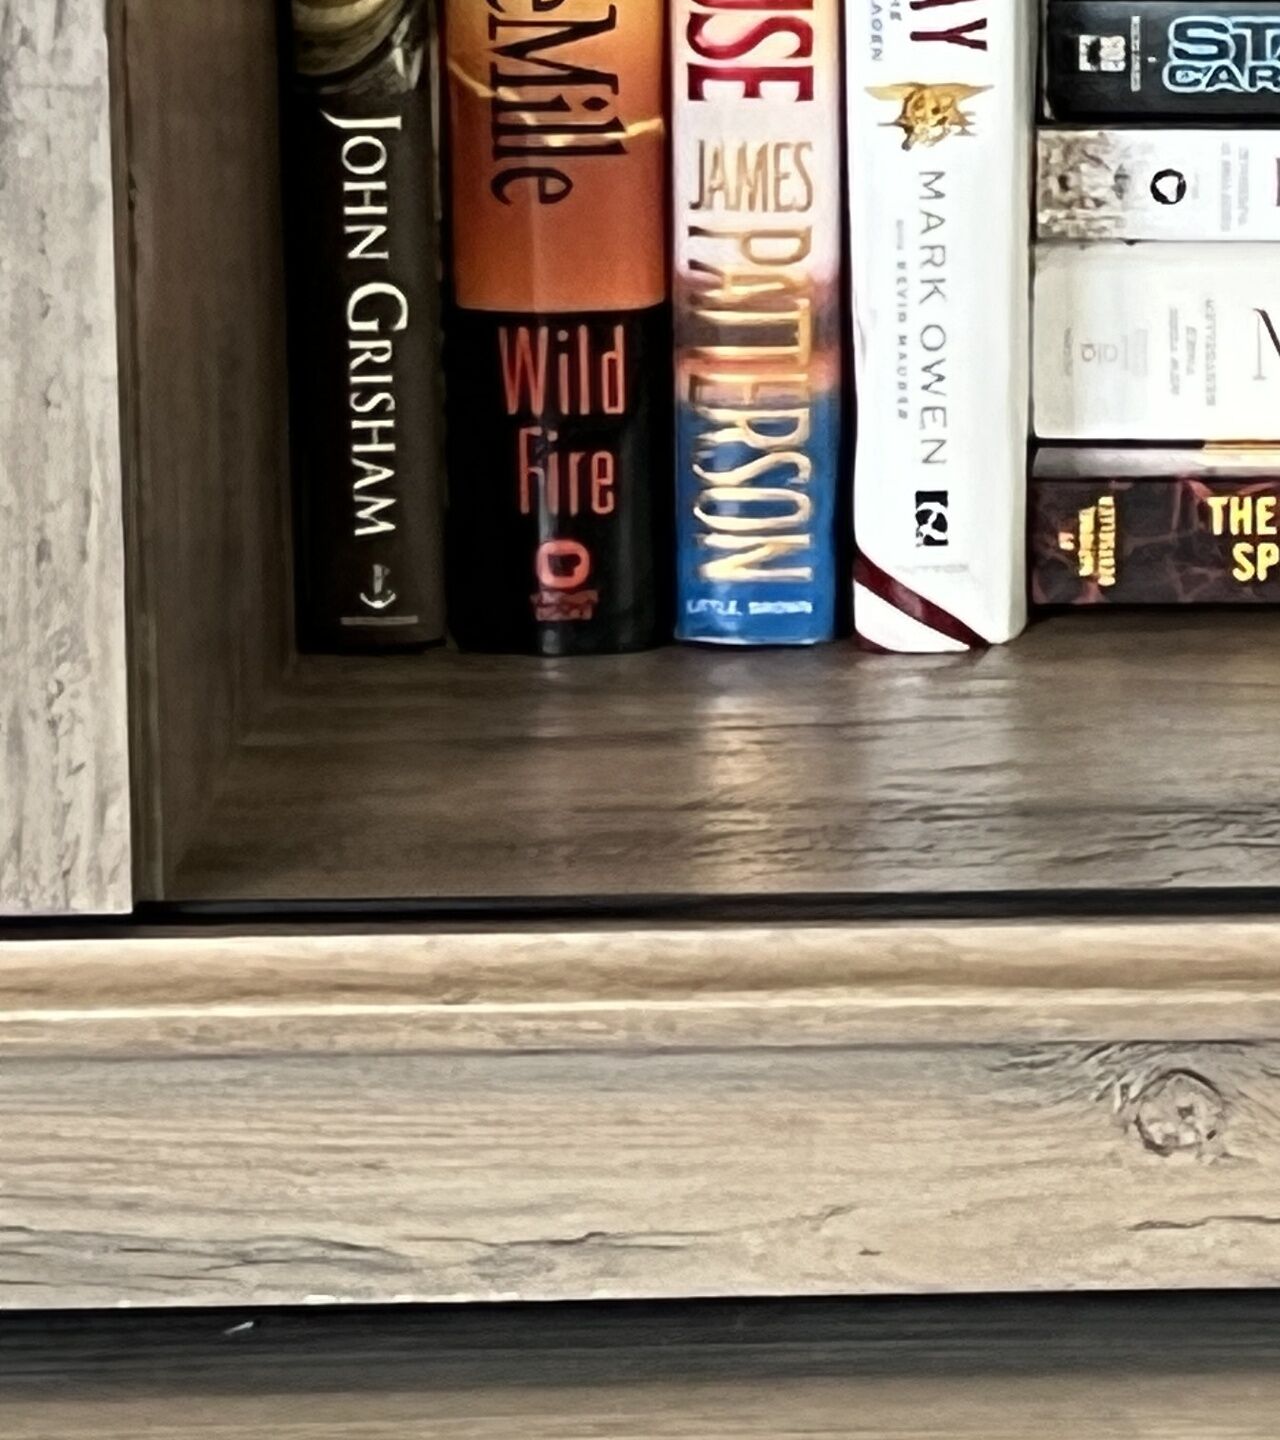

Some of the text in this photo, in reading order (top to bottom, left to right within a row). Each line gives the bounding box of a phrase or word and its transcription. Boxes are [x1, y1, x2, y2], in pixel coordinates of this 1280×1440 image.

[687, 139, 815, 214] JAMES
[319, 109, 410, 537] JOHN GRISHAM
[917, 171, 948, 465] MARK OWEN
[498, 323, 627, 416] Wild
[686, 224, 814, 584] PATTERSON
[516, 424, 617, 516] Fire
[1207, 495, 1278, 536] THE
